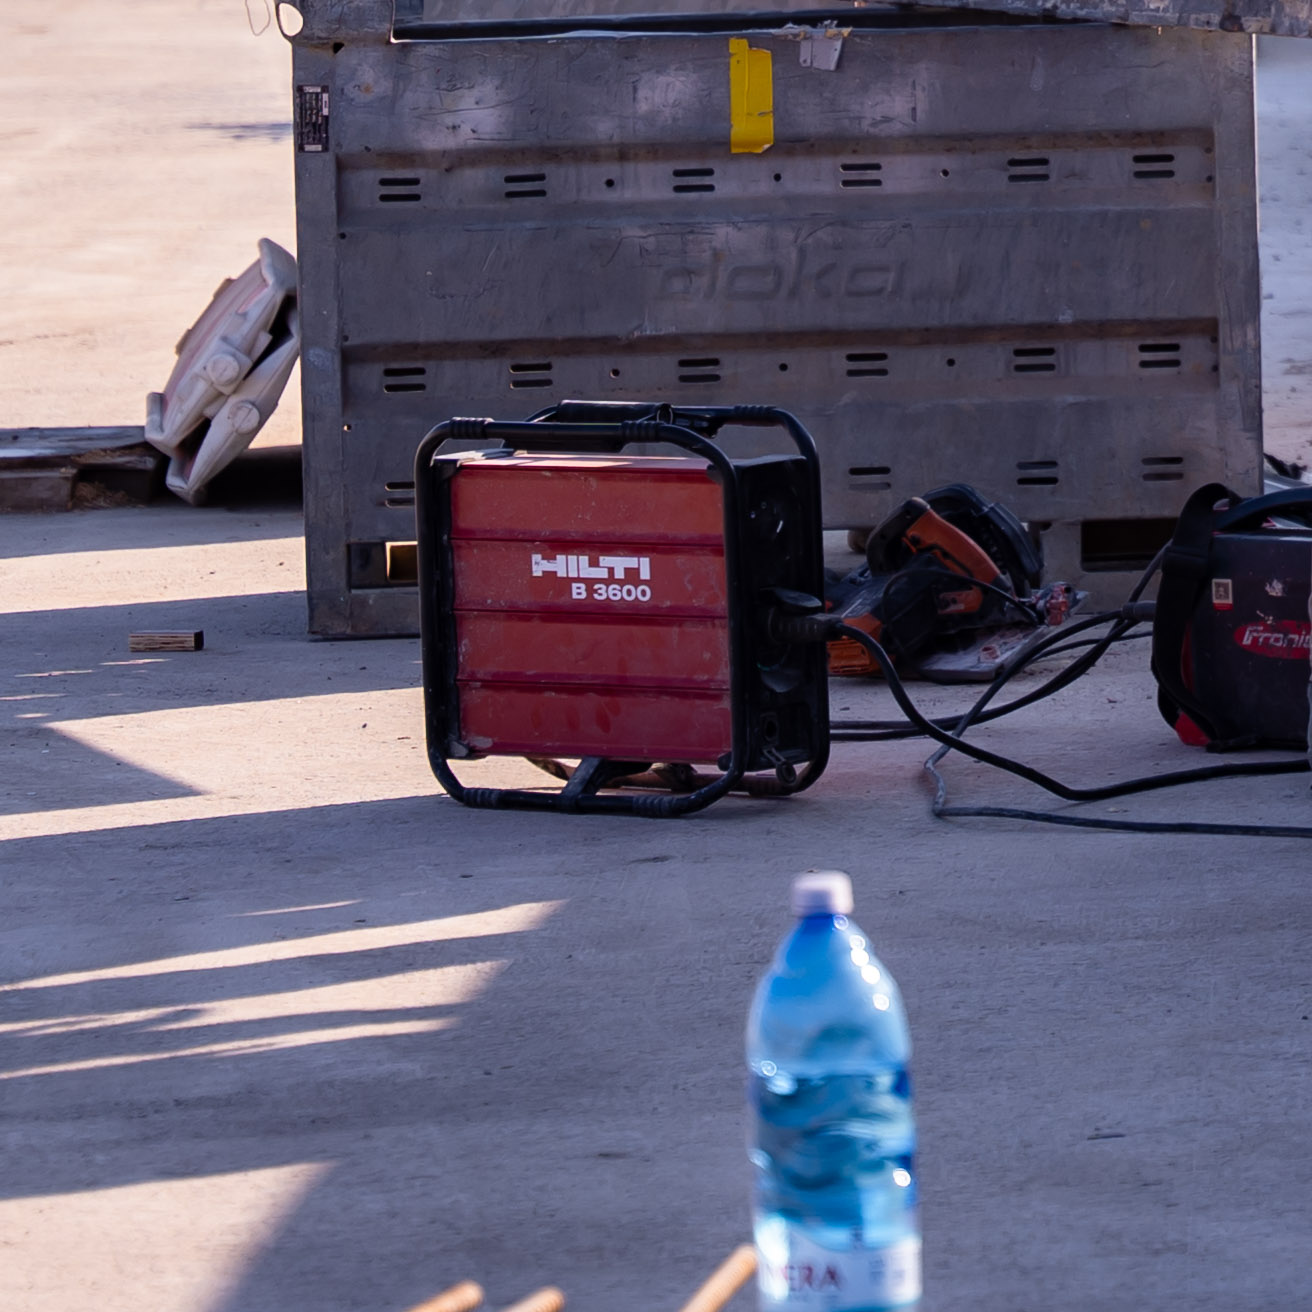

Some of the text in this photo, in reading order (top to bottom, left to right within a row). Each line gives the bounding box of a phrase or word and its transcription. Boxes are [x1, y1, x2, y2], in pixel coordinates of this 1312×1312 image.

[531, 553, 651, 581] HILTI
[571, 582, 652, 602] B 3600
